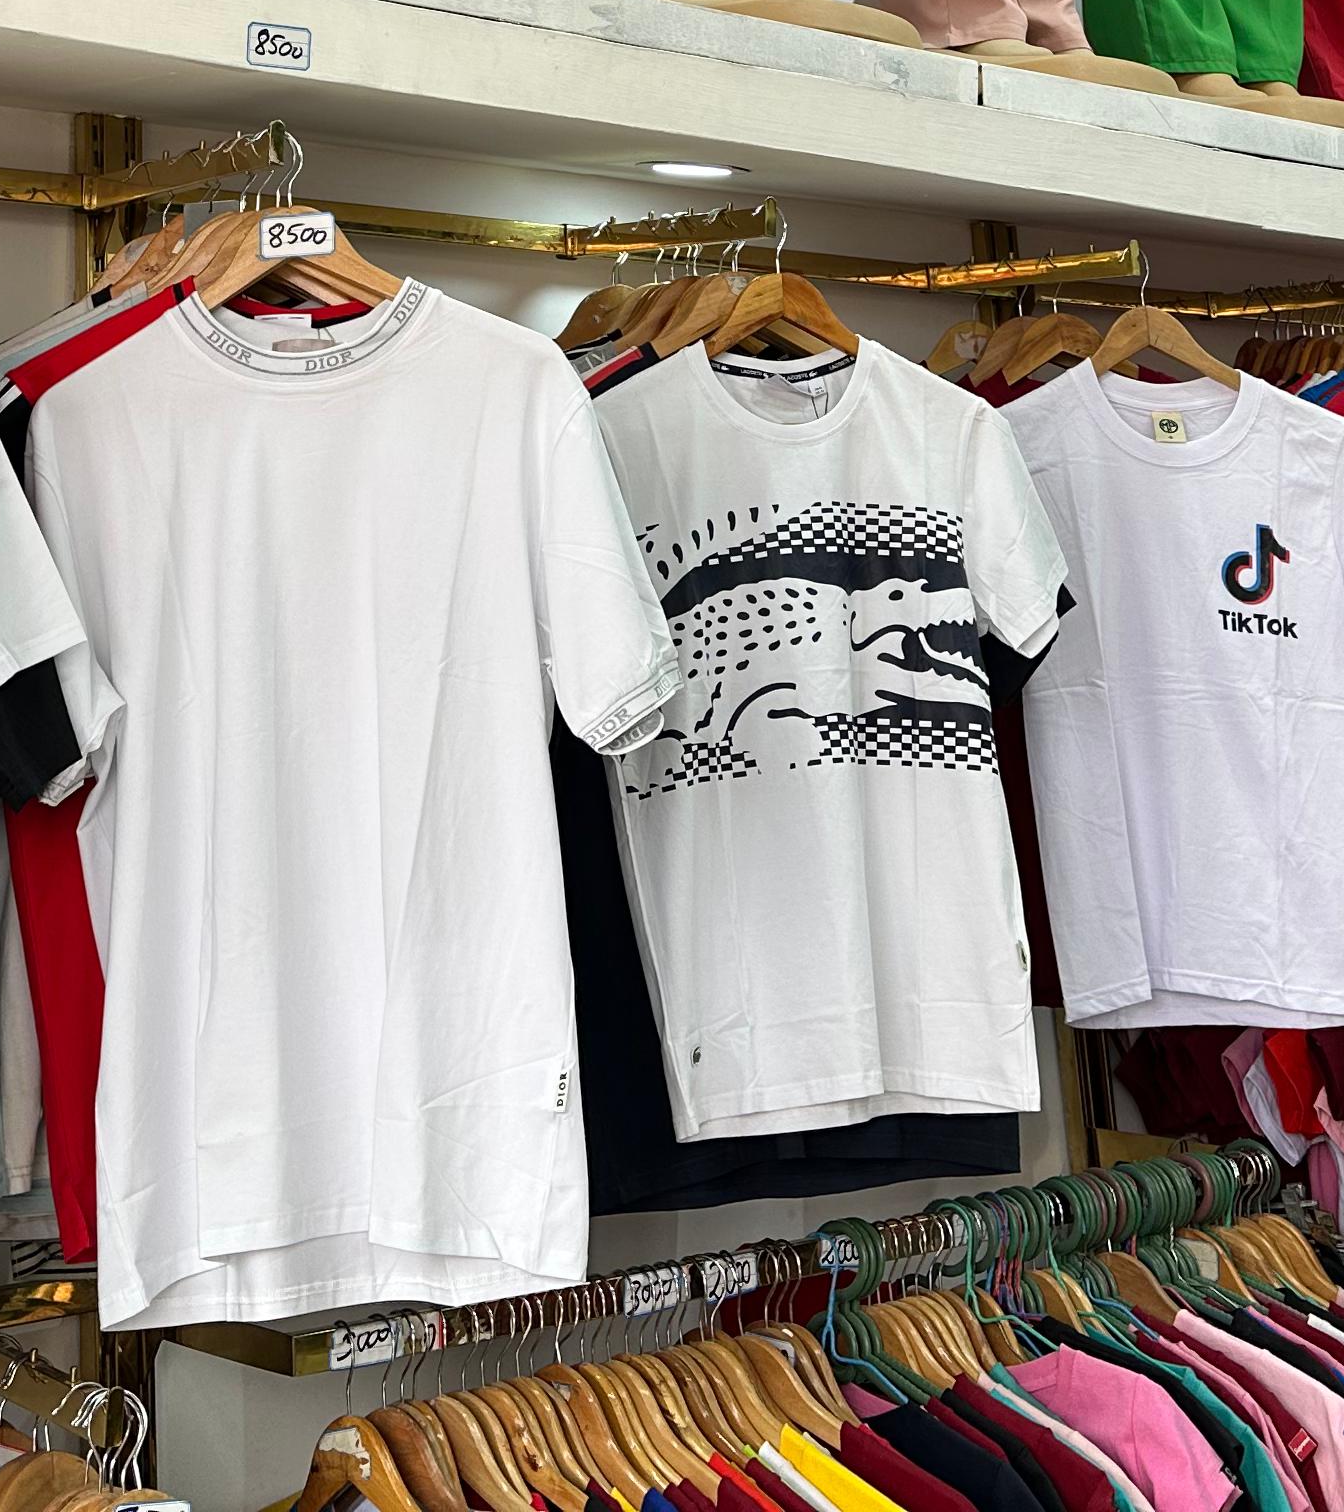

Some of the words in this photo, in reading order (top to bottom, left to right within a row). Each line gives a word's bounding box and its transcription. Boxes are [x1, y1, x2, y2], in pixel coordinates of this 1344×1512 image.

[255, 28, 304, 60] 8500
[268, 222, 328, 248] 8500
[206, 329, 253, 364] DIOR
[304, 350, 355, 372] DIOR
[1218, 609, 1300, 640] TikTok
[556, 1071, 568, 1108] DIOR
